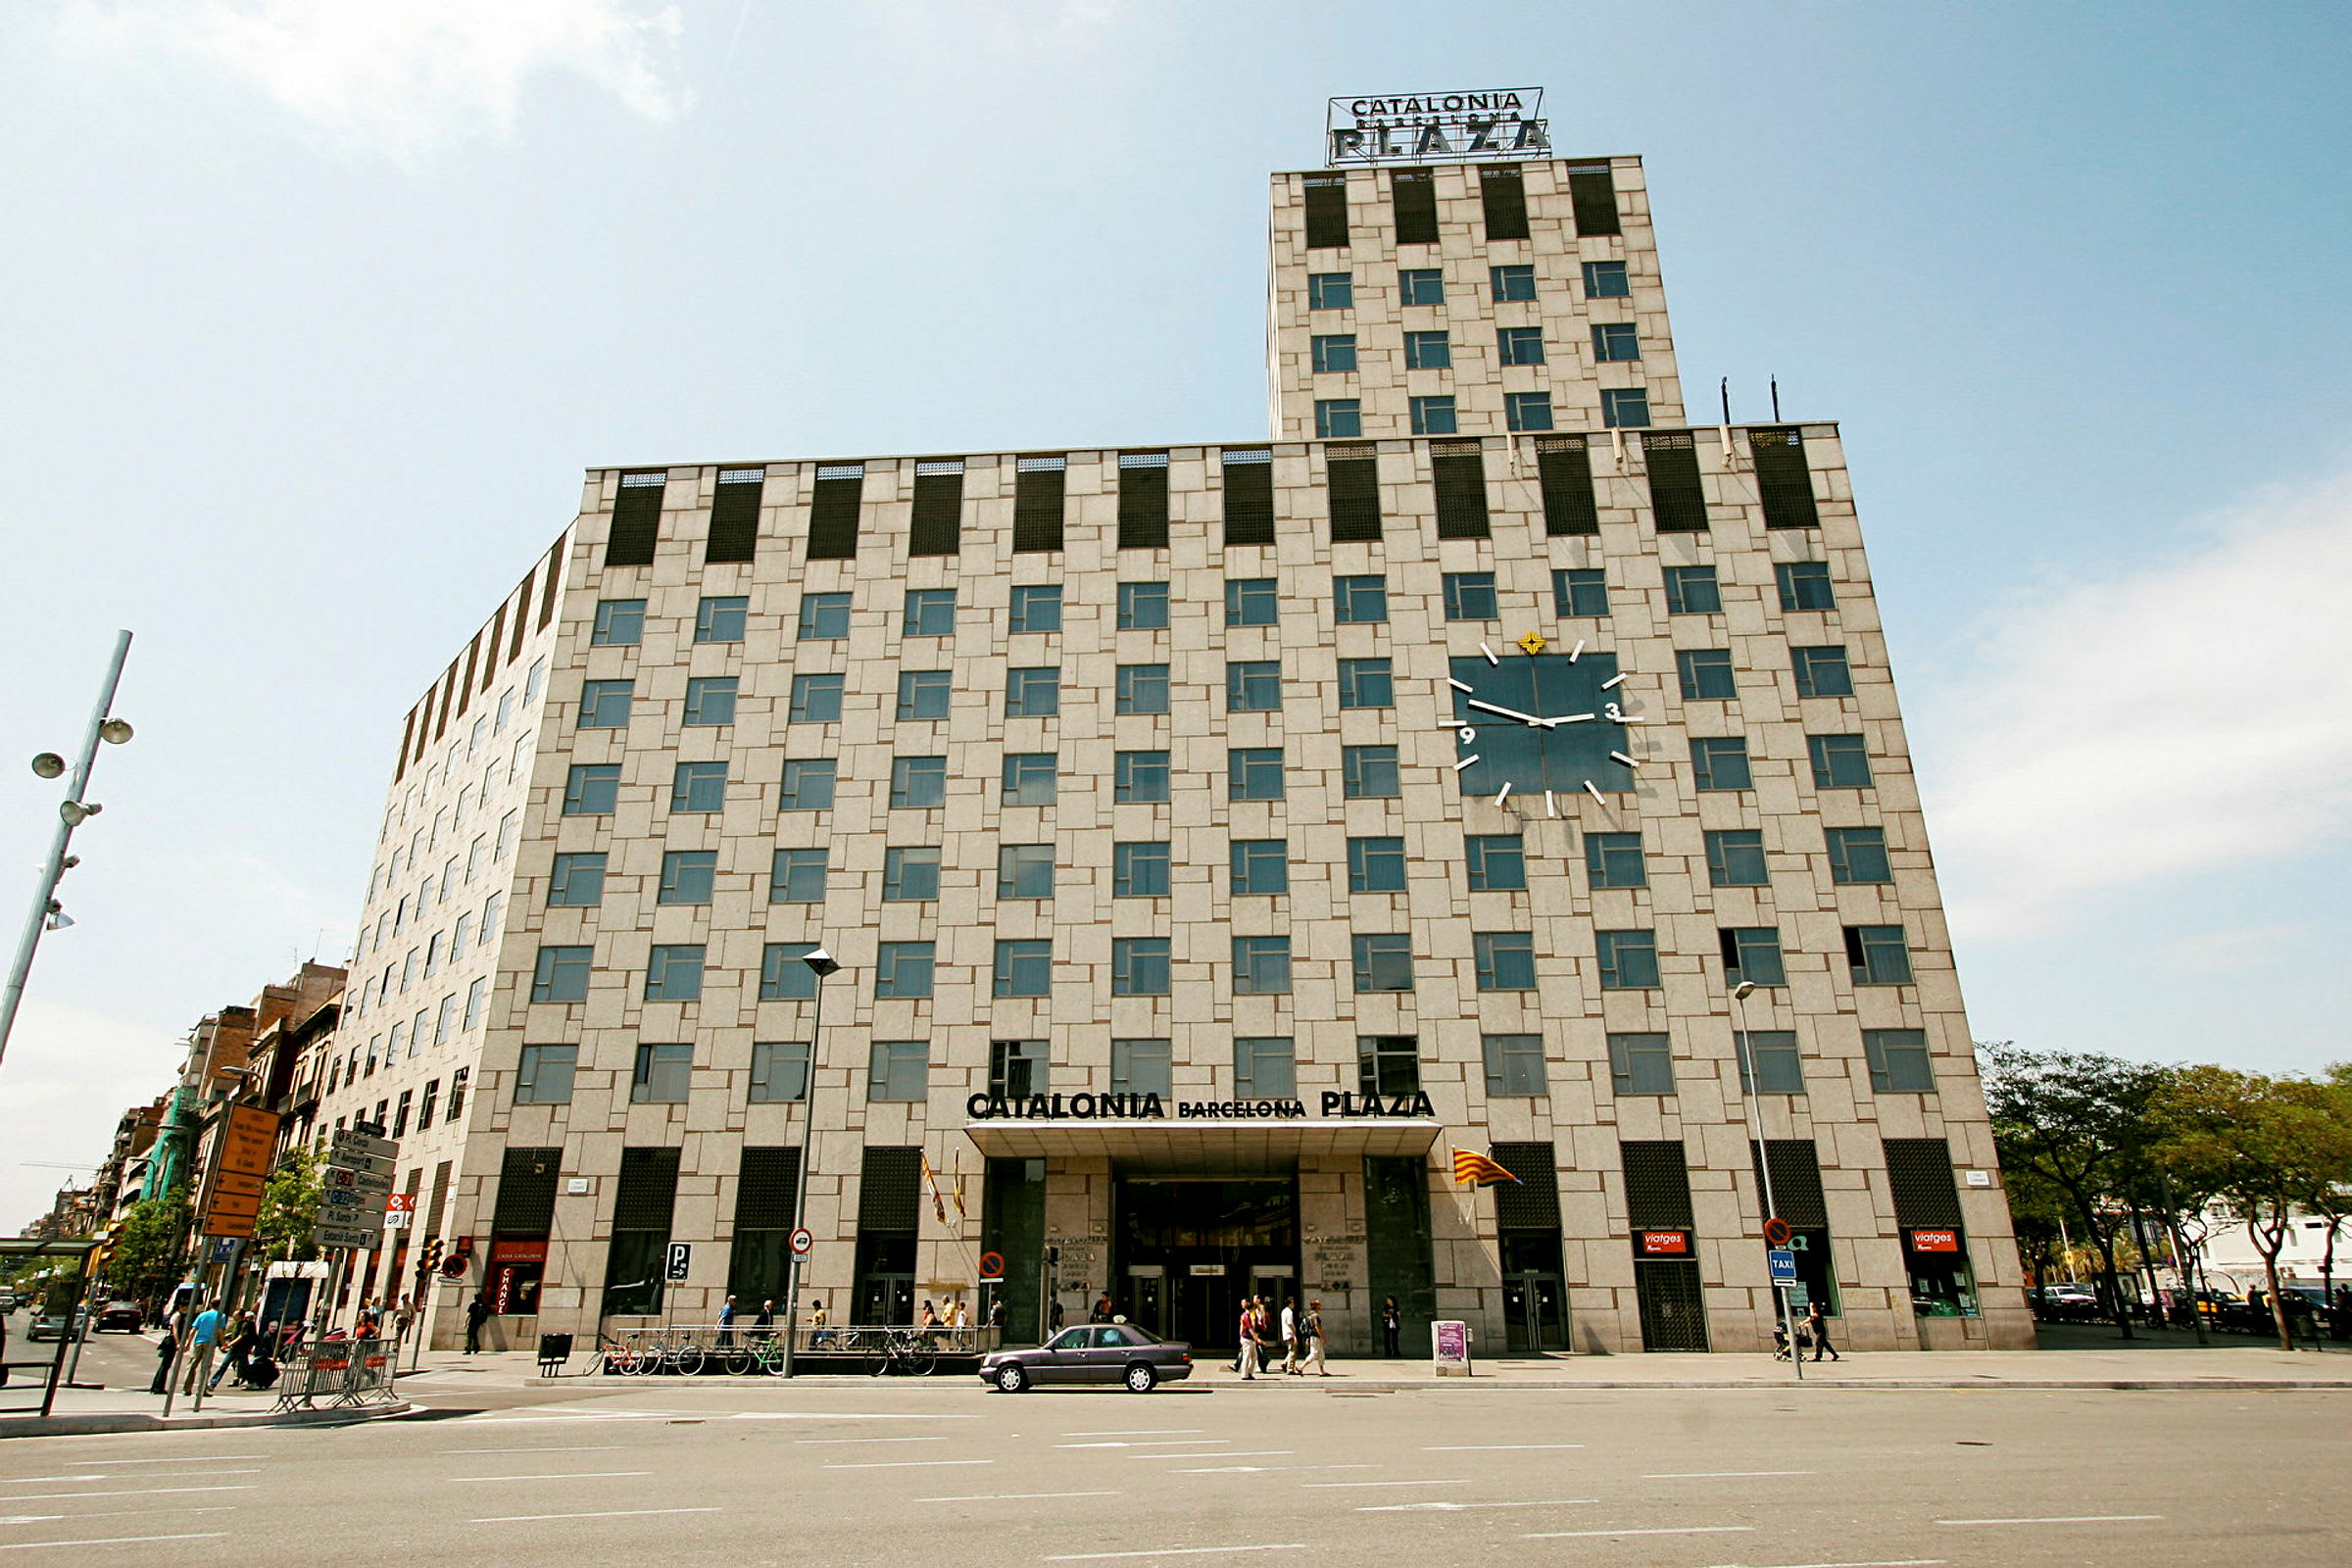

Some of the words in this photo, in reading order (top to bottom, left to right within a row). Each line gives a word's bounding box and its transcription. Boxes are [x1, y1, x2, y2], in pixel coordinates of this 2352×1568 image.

[1350, 92, 1522, 116] CATALONIA
[1355, 112, 1520, 129] BARCELONA
[1332, 120, 1551, 157] PLAZA
[1604, 702, 1621, 720] 3
[1459, 726, 1476, 745] 9
[966, 1093, 1165, 1119] CATALONIA
[1178, 1101, 1307, 1119] BARCELONA
[1321, 1091, 1437, 1118] PLAZA
[1644, 1233, 1683, 1246] viatges
[1914, 1232, 1952, 1245] viatges
[672, 1246, 685, 1266] P
[1772, 1259, 1794, 1269] TAXI
